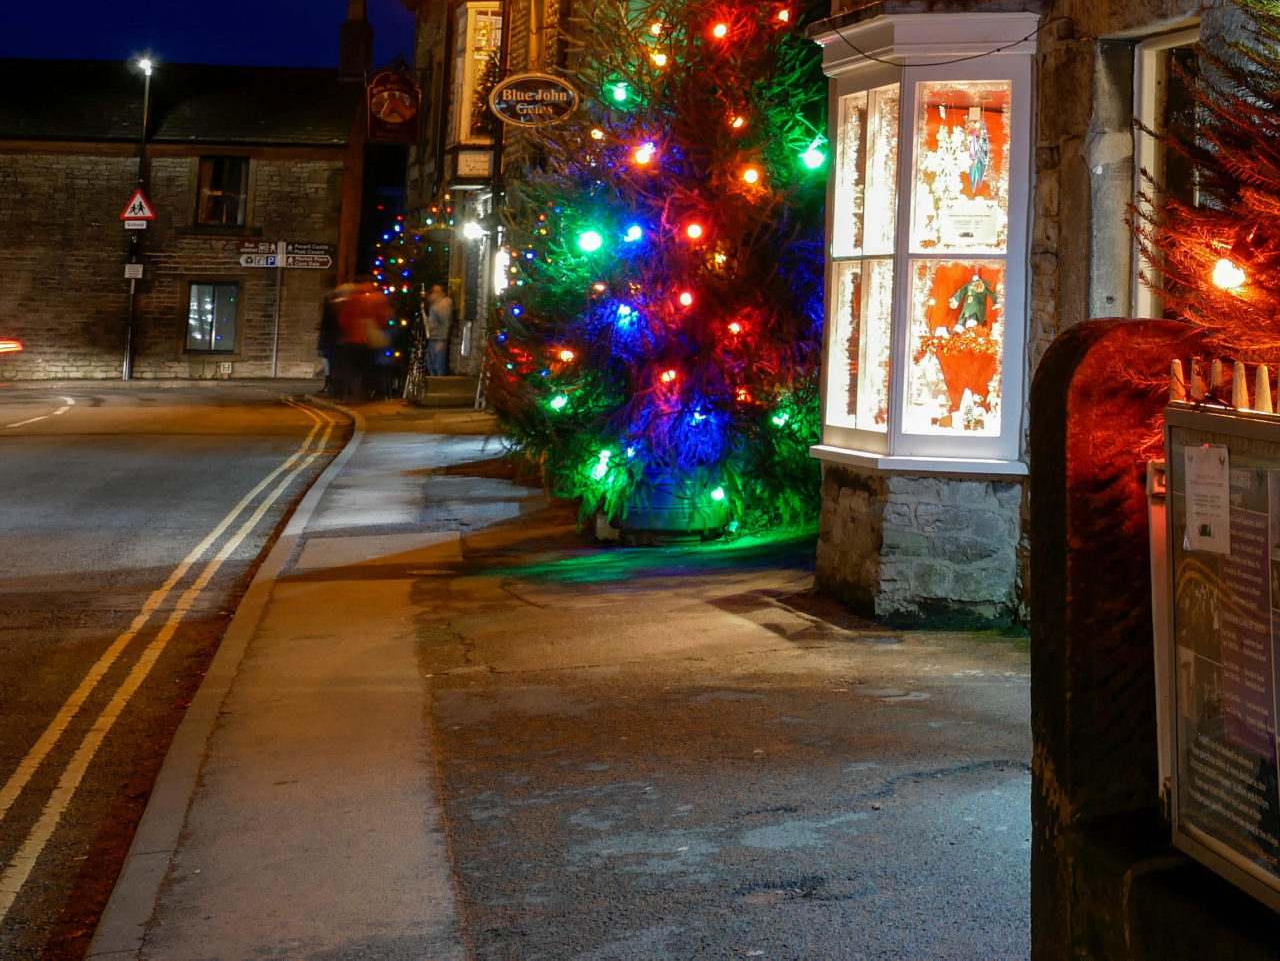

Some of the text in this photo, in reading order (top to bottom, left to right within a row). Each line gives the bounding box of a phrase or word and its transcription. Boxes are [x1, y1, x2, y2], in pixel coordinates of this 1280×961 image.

[502, 89, 567, 101] Blue John
[515, 102, 553, 115] Gems
